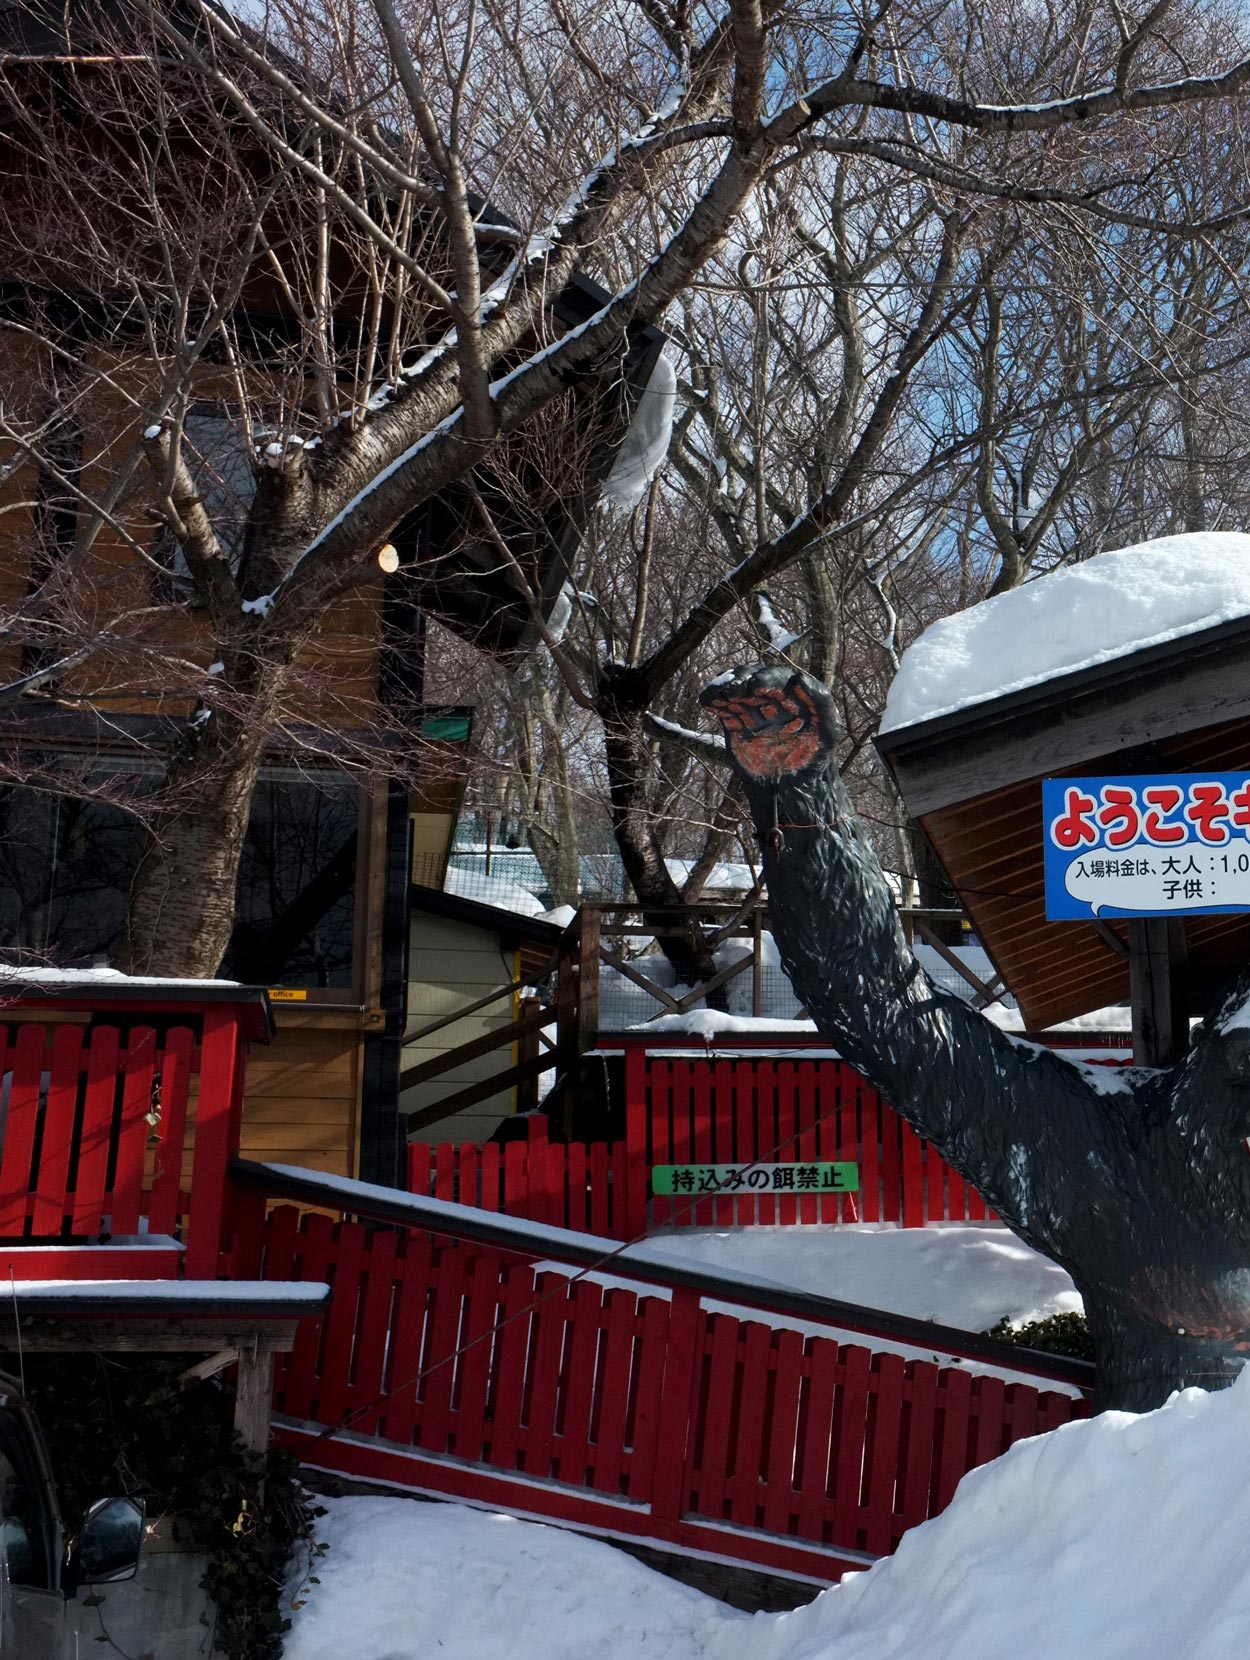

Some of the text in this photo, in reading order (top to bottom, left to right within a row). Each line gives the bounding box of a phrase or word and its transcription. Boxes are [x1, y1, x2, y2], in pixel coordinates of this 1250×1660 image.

[671, 1165, 844, 1193] 持込みの餌禁止
